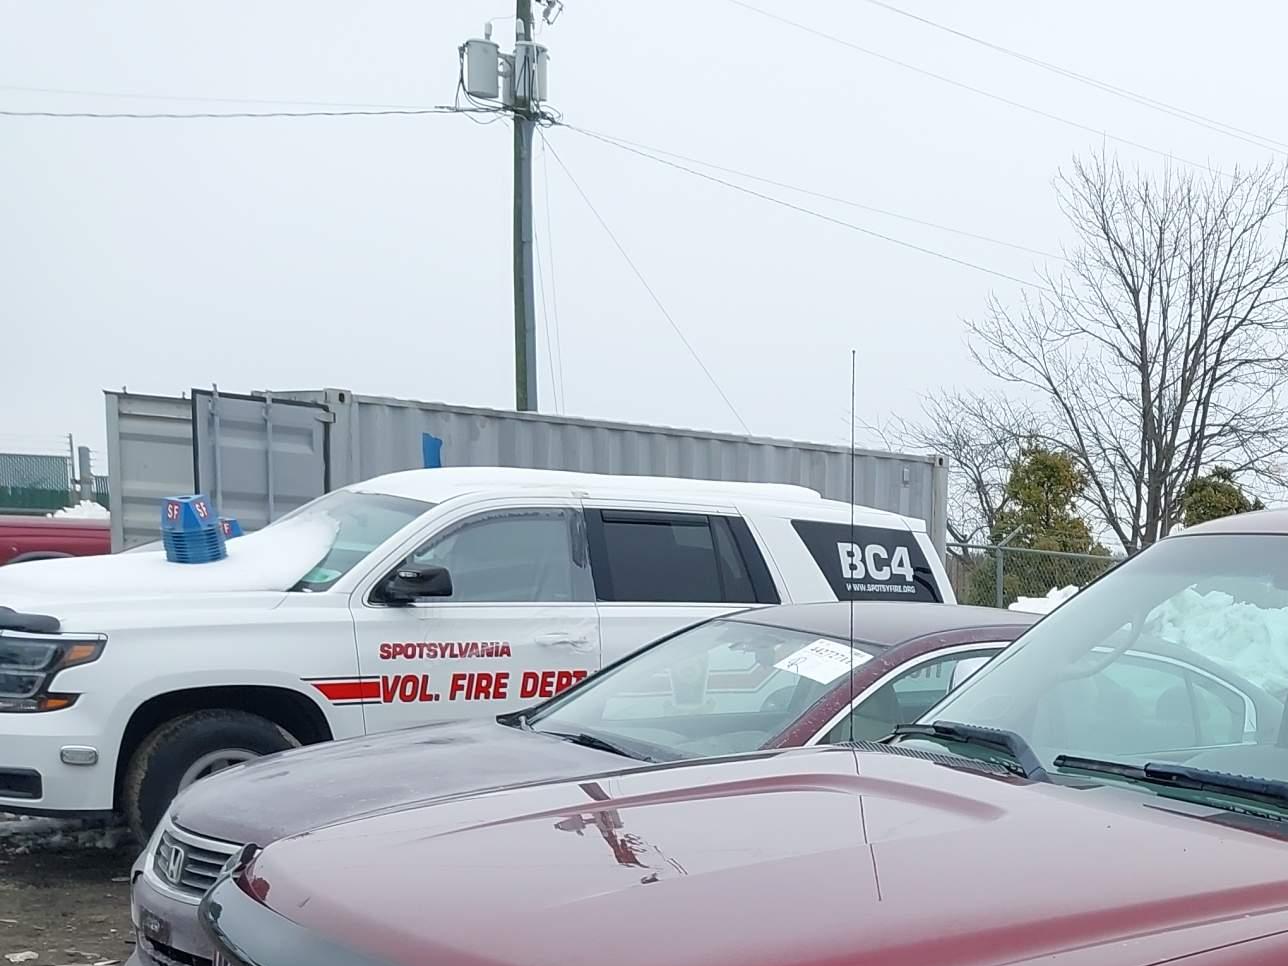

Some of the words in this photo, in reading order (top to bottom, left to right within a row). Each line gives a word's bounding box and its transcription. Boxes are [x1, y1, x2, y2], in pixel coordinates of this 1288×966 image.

[167, 503, 180, 519] SF
[837, 542, 914, 582] BC4
[380, 641, 512, 659] SPOTSYLVANIA
[381, 674, 440, 703] VOL.
[449, 672, 510, 700] FIRE
